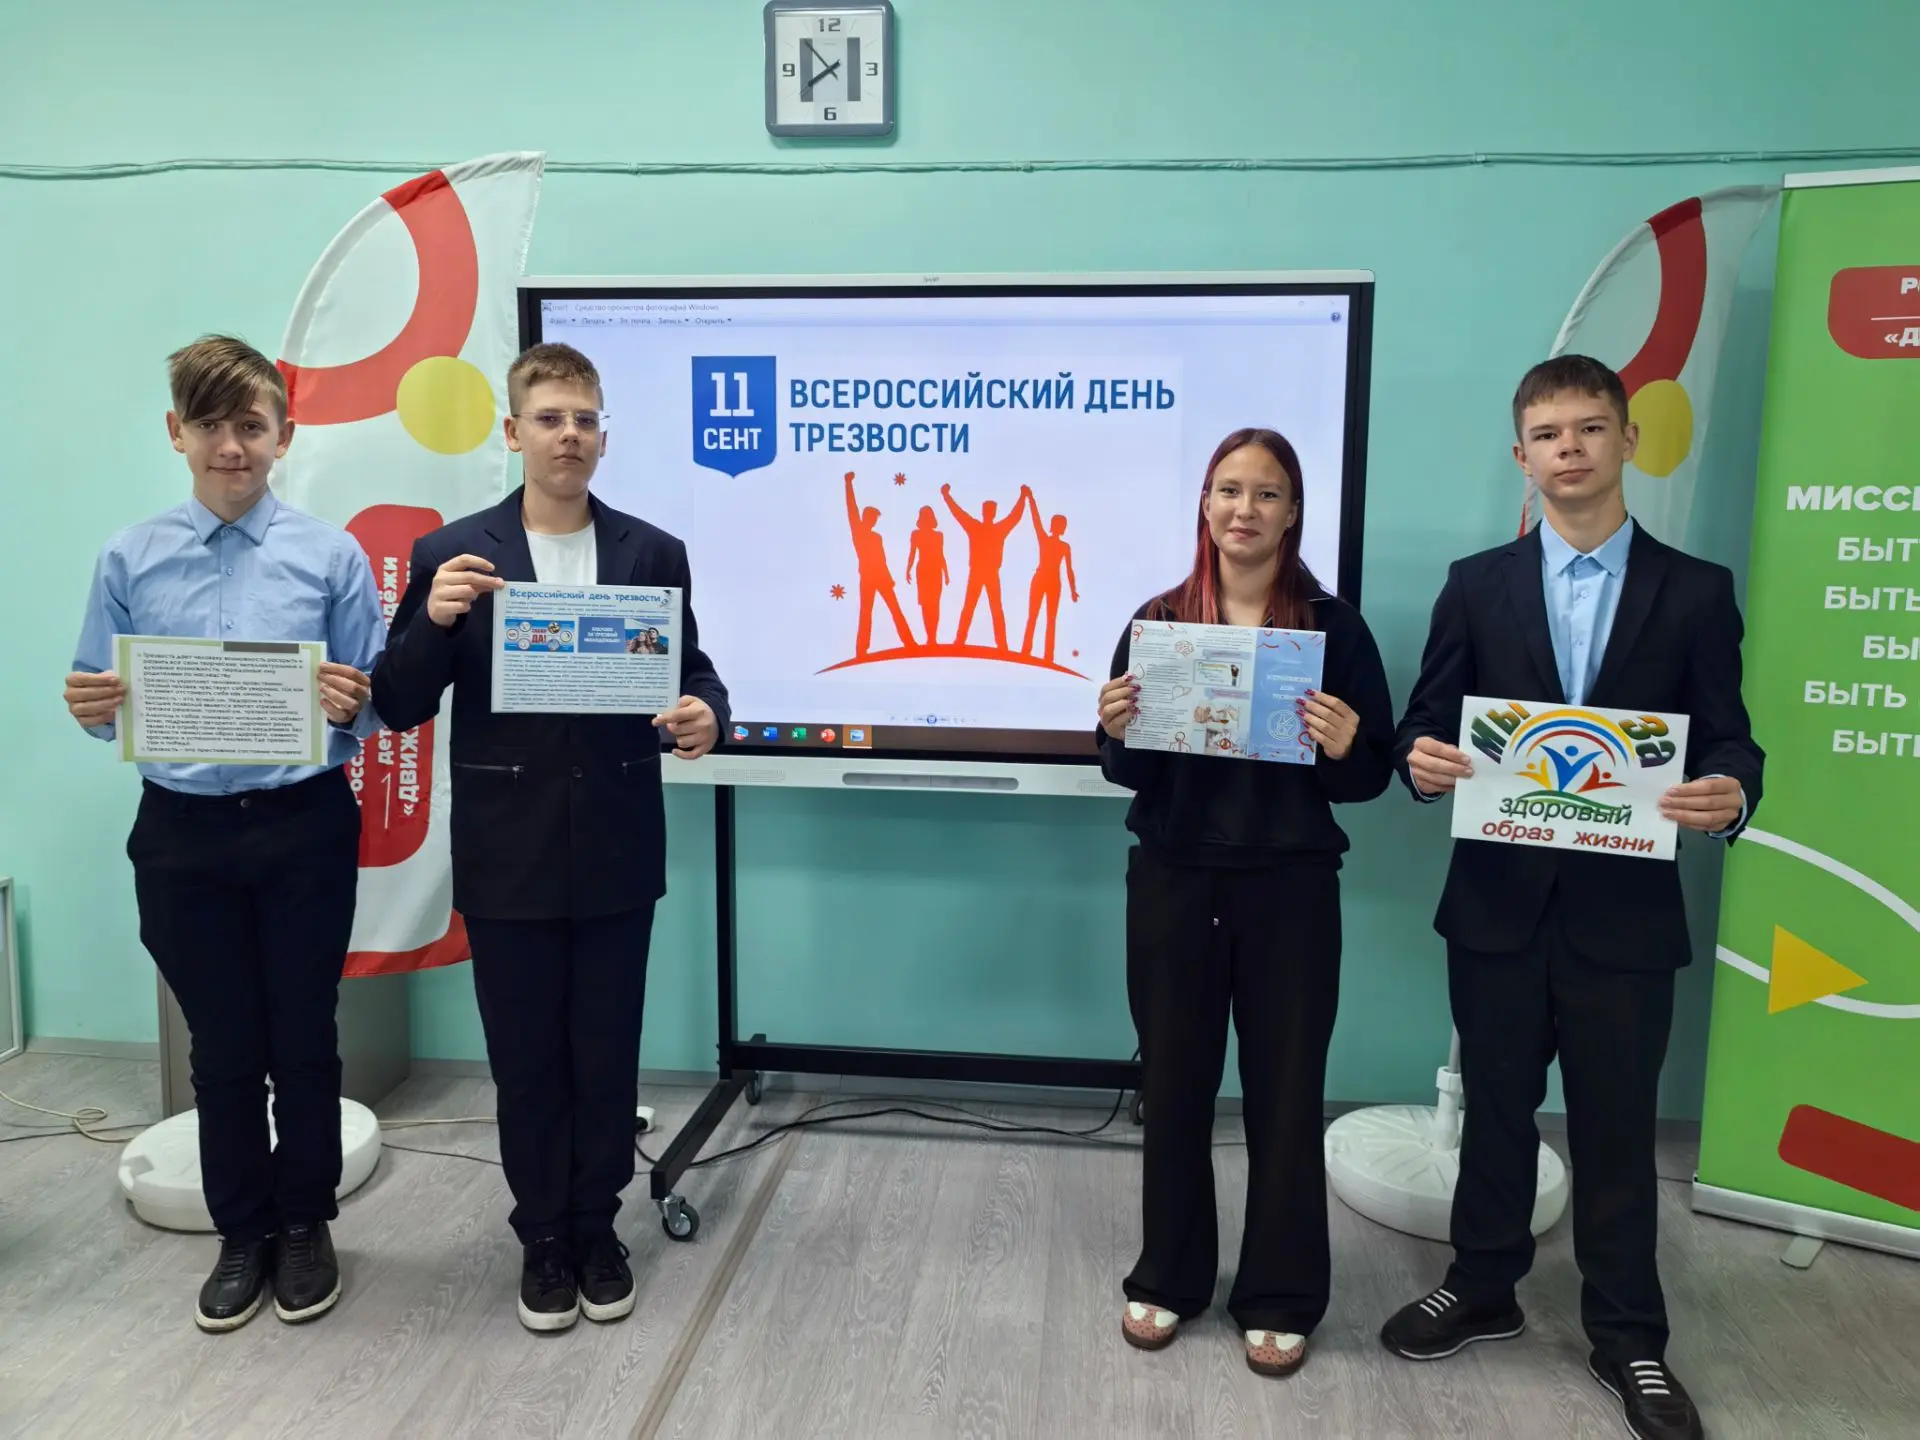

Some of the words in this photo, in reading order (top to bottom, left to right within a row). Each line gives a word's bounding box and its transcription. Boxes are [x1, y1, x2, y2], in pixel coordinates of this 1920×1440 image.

[818, 17, 841, 32] 12
[782, 63, 795, 77] 9
[865, 62, 878, 76] 3
[824, 107, 837, 121] 6
[1901, 277, 1920, 294] Р
[709, 371, 755, 417] 11
[790, 371, 1074, 409] ВСЕРОССИЙСКИЙ
[1084, 379, 1175, 413] ДЕНЬ
[703, 427, 762, 450] СЕНТ
[789, 422, 970, 453] ТРЕЗВОСТИ
[1786, 485, 1920, 512] МИСС
[1838, 537, 1920, 562] БЫТ
[509, 588, 585, 600] Всероссийский
[588, 593, 611, 601] день
[615, 594, 661, 603] трезвости
[1804, 680, 1907, 708] БЫТЬ
[1832, 729, 1920, 758] БЫТ
[1499, 797, 1632, 825] здоровый
[1482, 819, 1555, 842] образ
[1573, 831, 1655, 852] жизни
